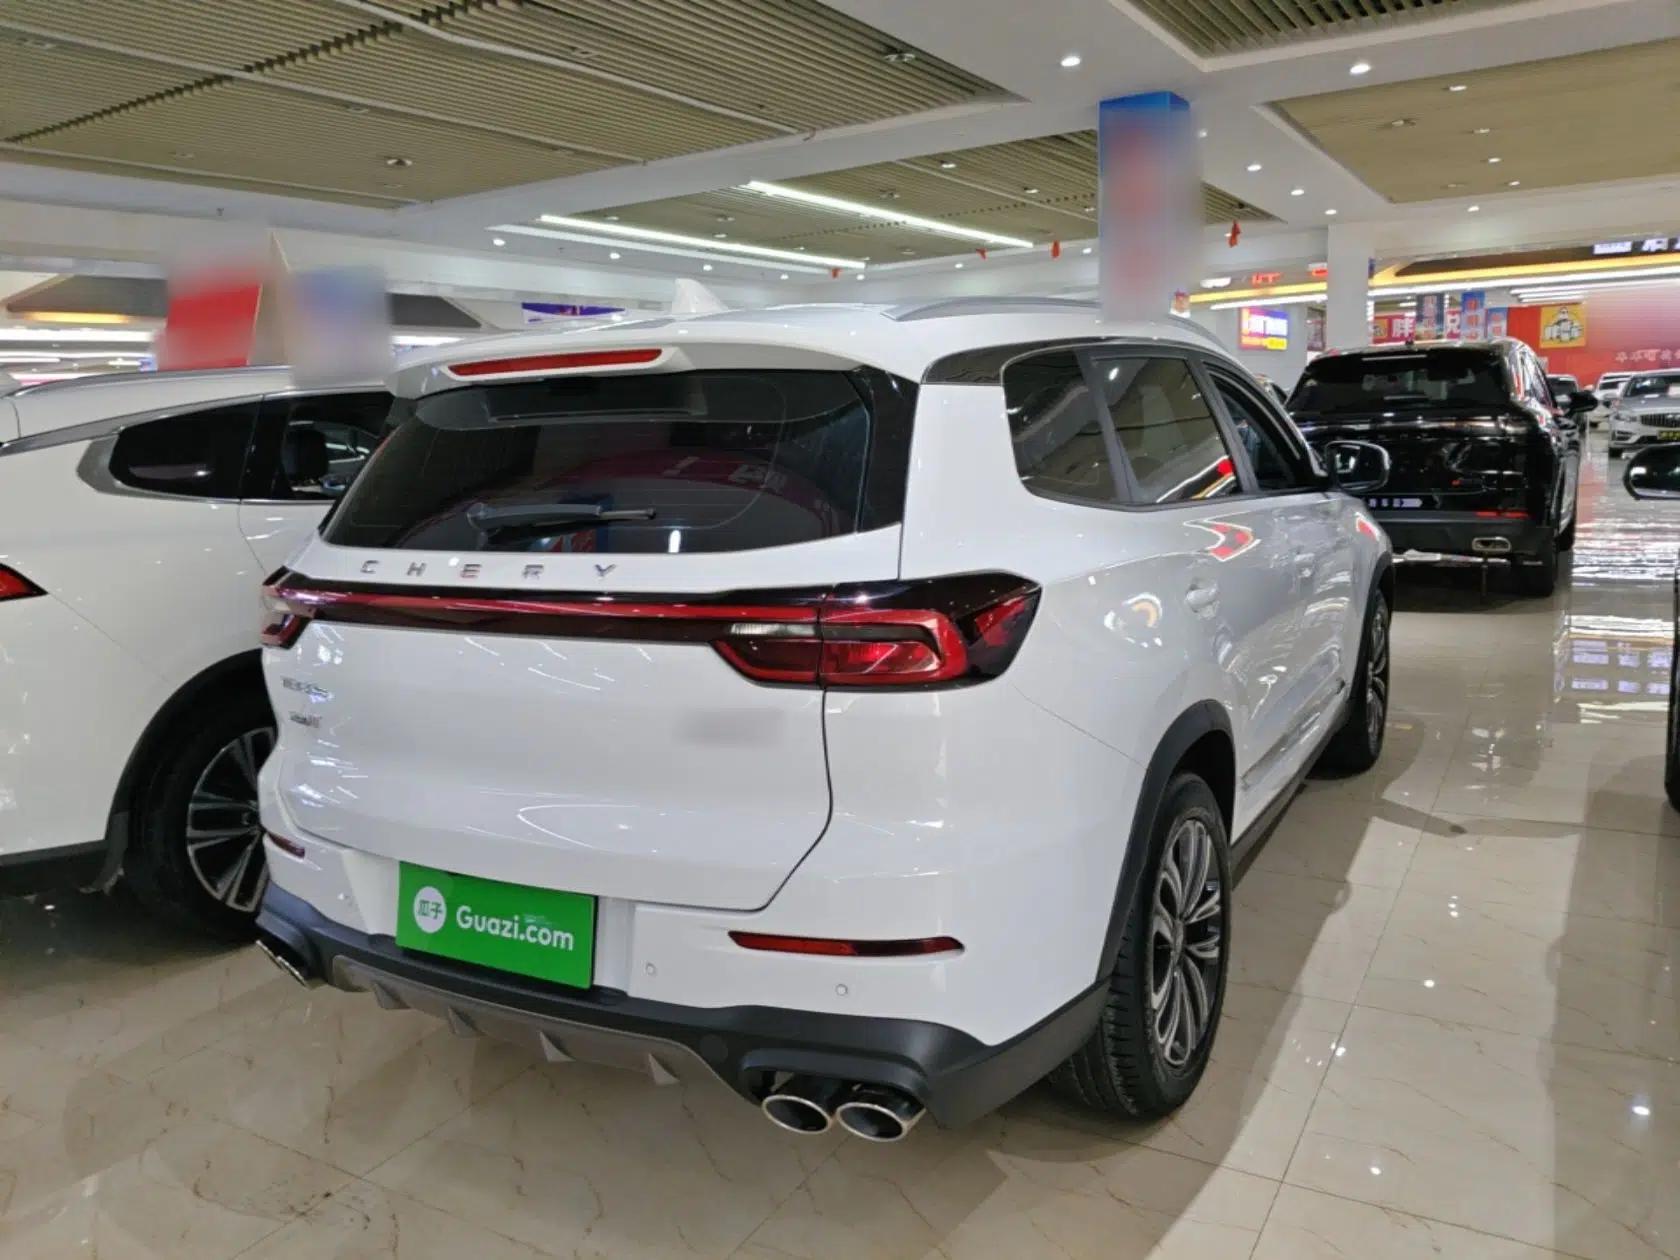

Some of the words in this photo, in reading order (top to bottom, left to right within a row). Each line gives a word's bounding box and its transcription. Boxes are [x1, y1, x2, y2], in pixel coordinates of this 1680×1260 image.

[360, 559, 616, 580] CHERY
[417, 898, 443, 920] 瓜子
[456, 905, 574, 951] Guazi.com
